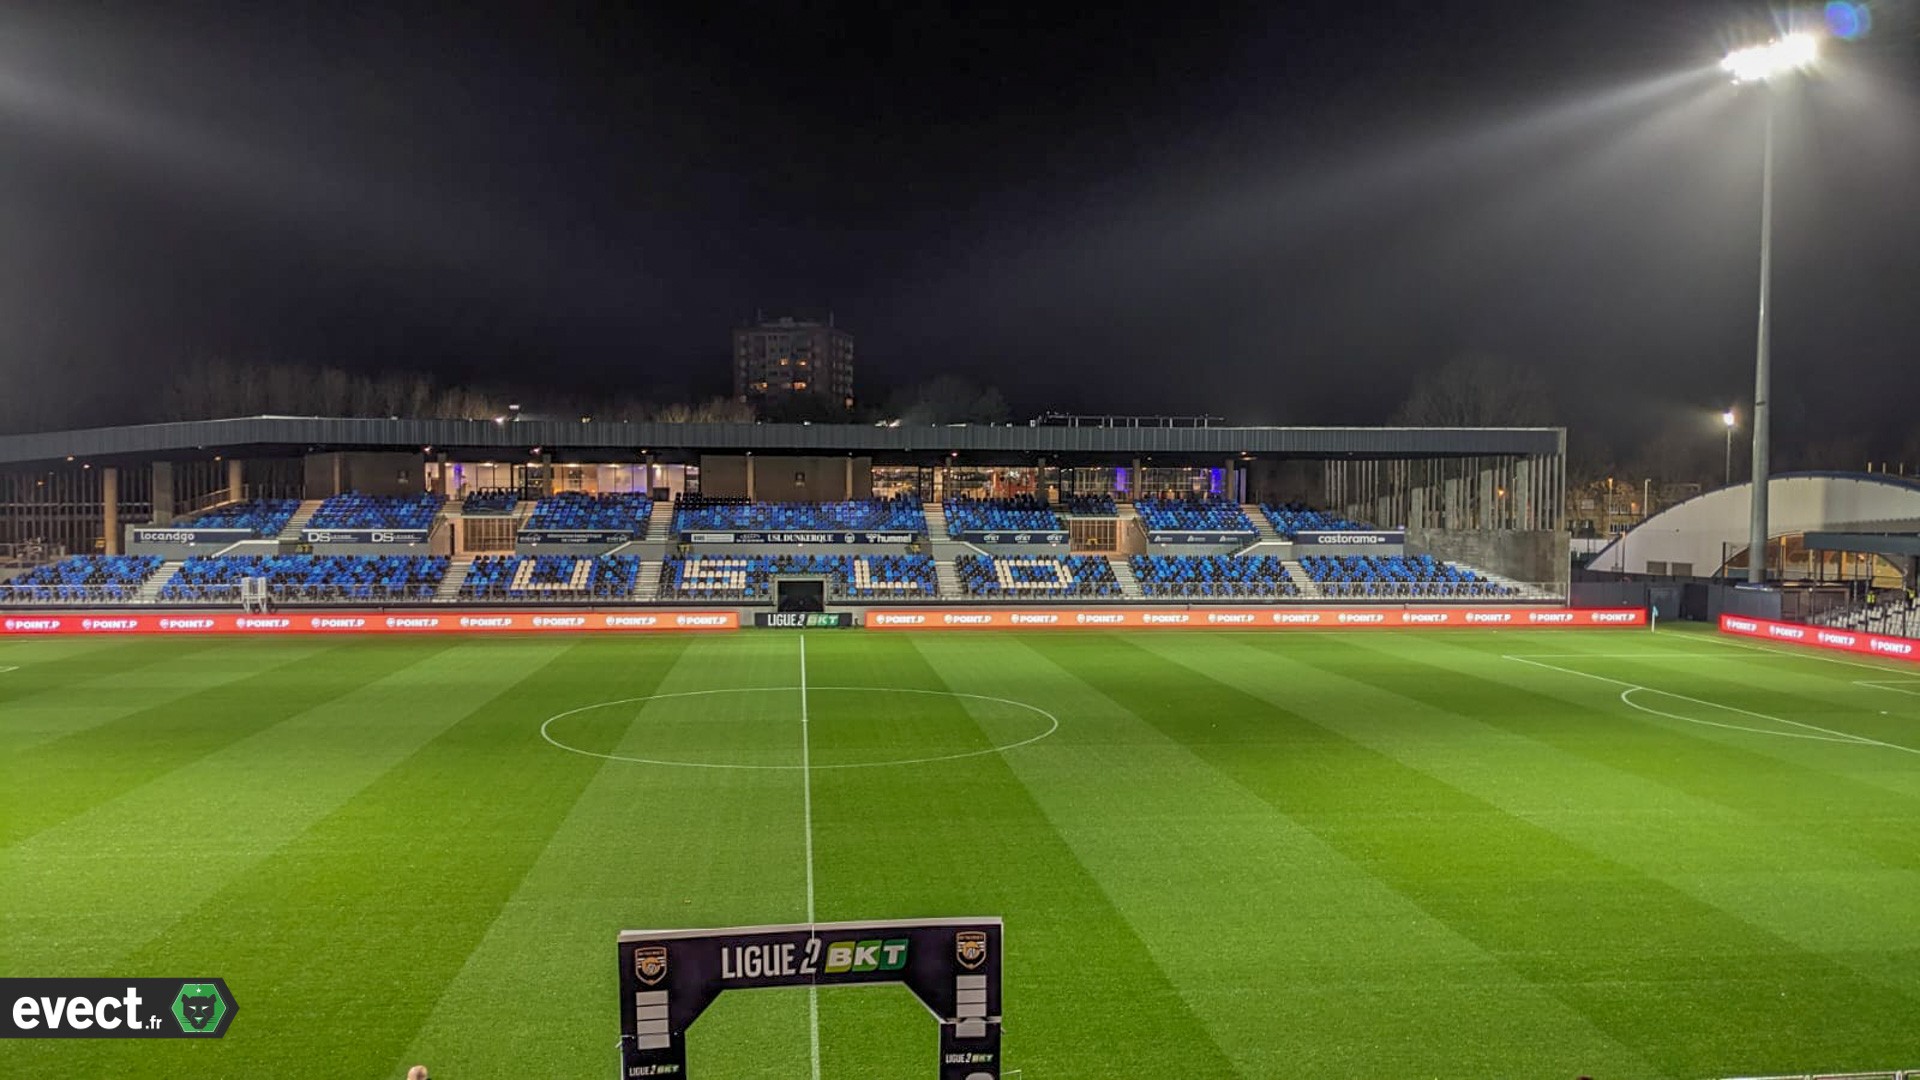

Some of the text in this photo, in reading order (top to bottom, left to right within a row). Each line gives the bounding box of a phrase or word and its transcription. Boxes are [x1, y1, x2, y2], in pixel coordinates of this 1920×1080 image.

[140, 531, 195, 541] locandgo
[308, 532, 331, 543] DS
[371, 532, 394, 543] DS
[877, 533, 912, 543] hummel
[1318, 534, 1377, 544] castorama
[682, 559, 747, 589] S
[854, 559, 918, 588] L
[543, 617, 585, 626] POINT.P
[615, 616, 657, 626] POINT.P
[686, 616, 728, 625] POINT.P
[767, 613, 797, 626] LIGUE
[796, 613, 806, 626] 2
[885, 615, 925, 624] POINT.P
[953, 615, 992, 623] POINT.P
[1020, 615, 1058, 623] POINT.P
[1086, 614, 1124, 623] POINT.P
[1152, 614, 1189, 623] POINT.P
[1217, 614, 1255, 623] POINT.P
[1282, 614, 1320, 623] POINT.P
[1347, 614, 1384, 622] POINT.P
[1411, 613, 1448, 622] POINT.P
[1474, 613, 1511, 622] POINT.P
[1538, 613, 1573, 622] POINT.P
[1600, 613, 1636, 621] POINT.P
[15, 620, 61, 630] POINT.P
[93, 619, 138, 629] POINT.P
[170, 619, 215, 629] POINT.P
[246, 619, 290, 628] POINT.P
[321, 618, 365, 628] POINT.P
[396, 618, 439, 627] POINT.P
[470, 618, 512, 627] POINT.P
[721, 938, 906, 979] LIGUE 2 BKT
